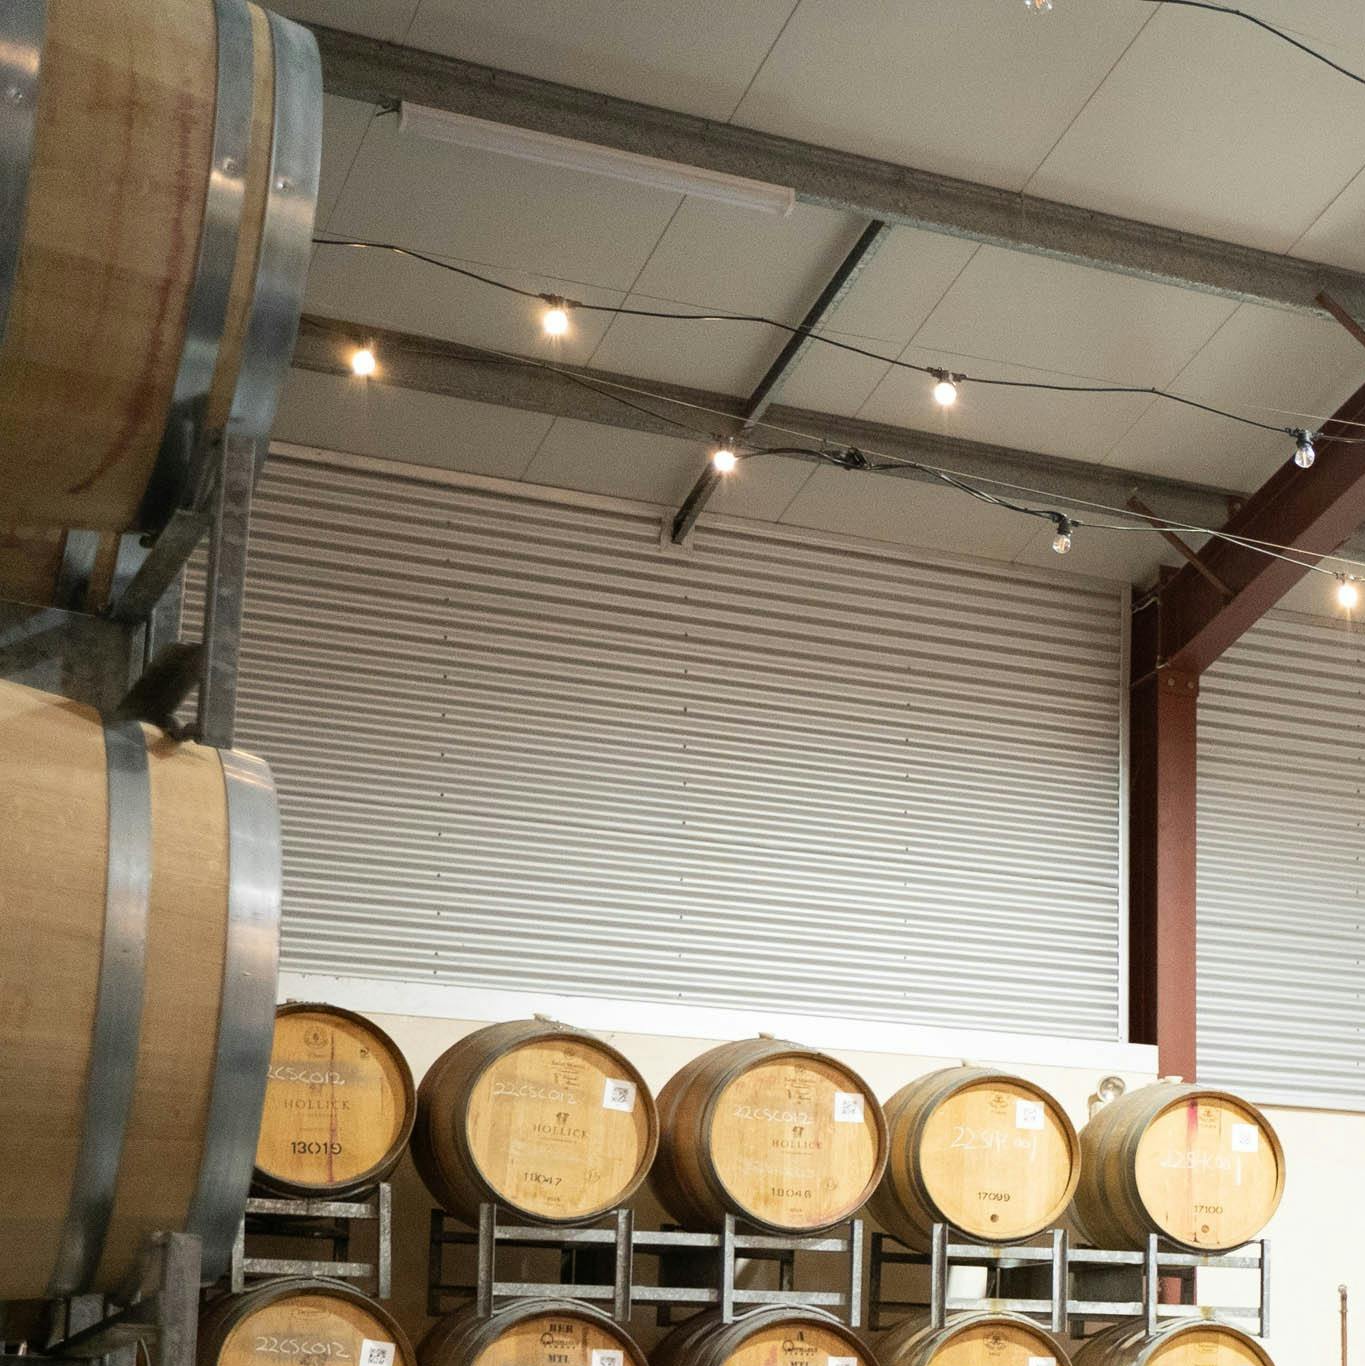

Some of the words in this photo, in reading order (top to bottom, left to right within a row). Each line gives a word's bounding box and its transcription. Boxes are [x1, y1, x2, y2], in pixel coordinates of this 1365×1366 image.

[284, 1099, 351, 1110] HOLLICK
[533, 1122, 589, 1138] HOLLICK
[291, 1142, 342, 1155] 13019
[1194, 1205, 1223, 1215] 17100
